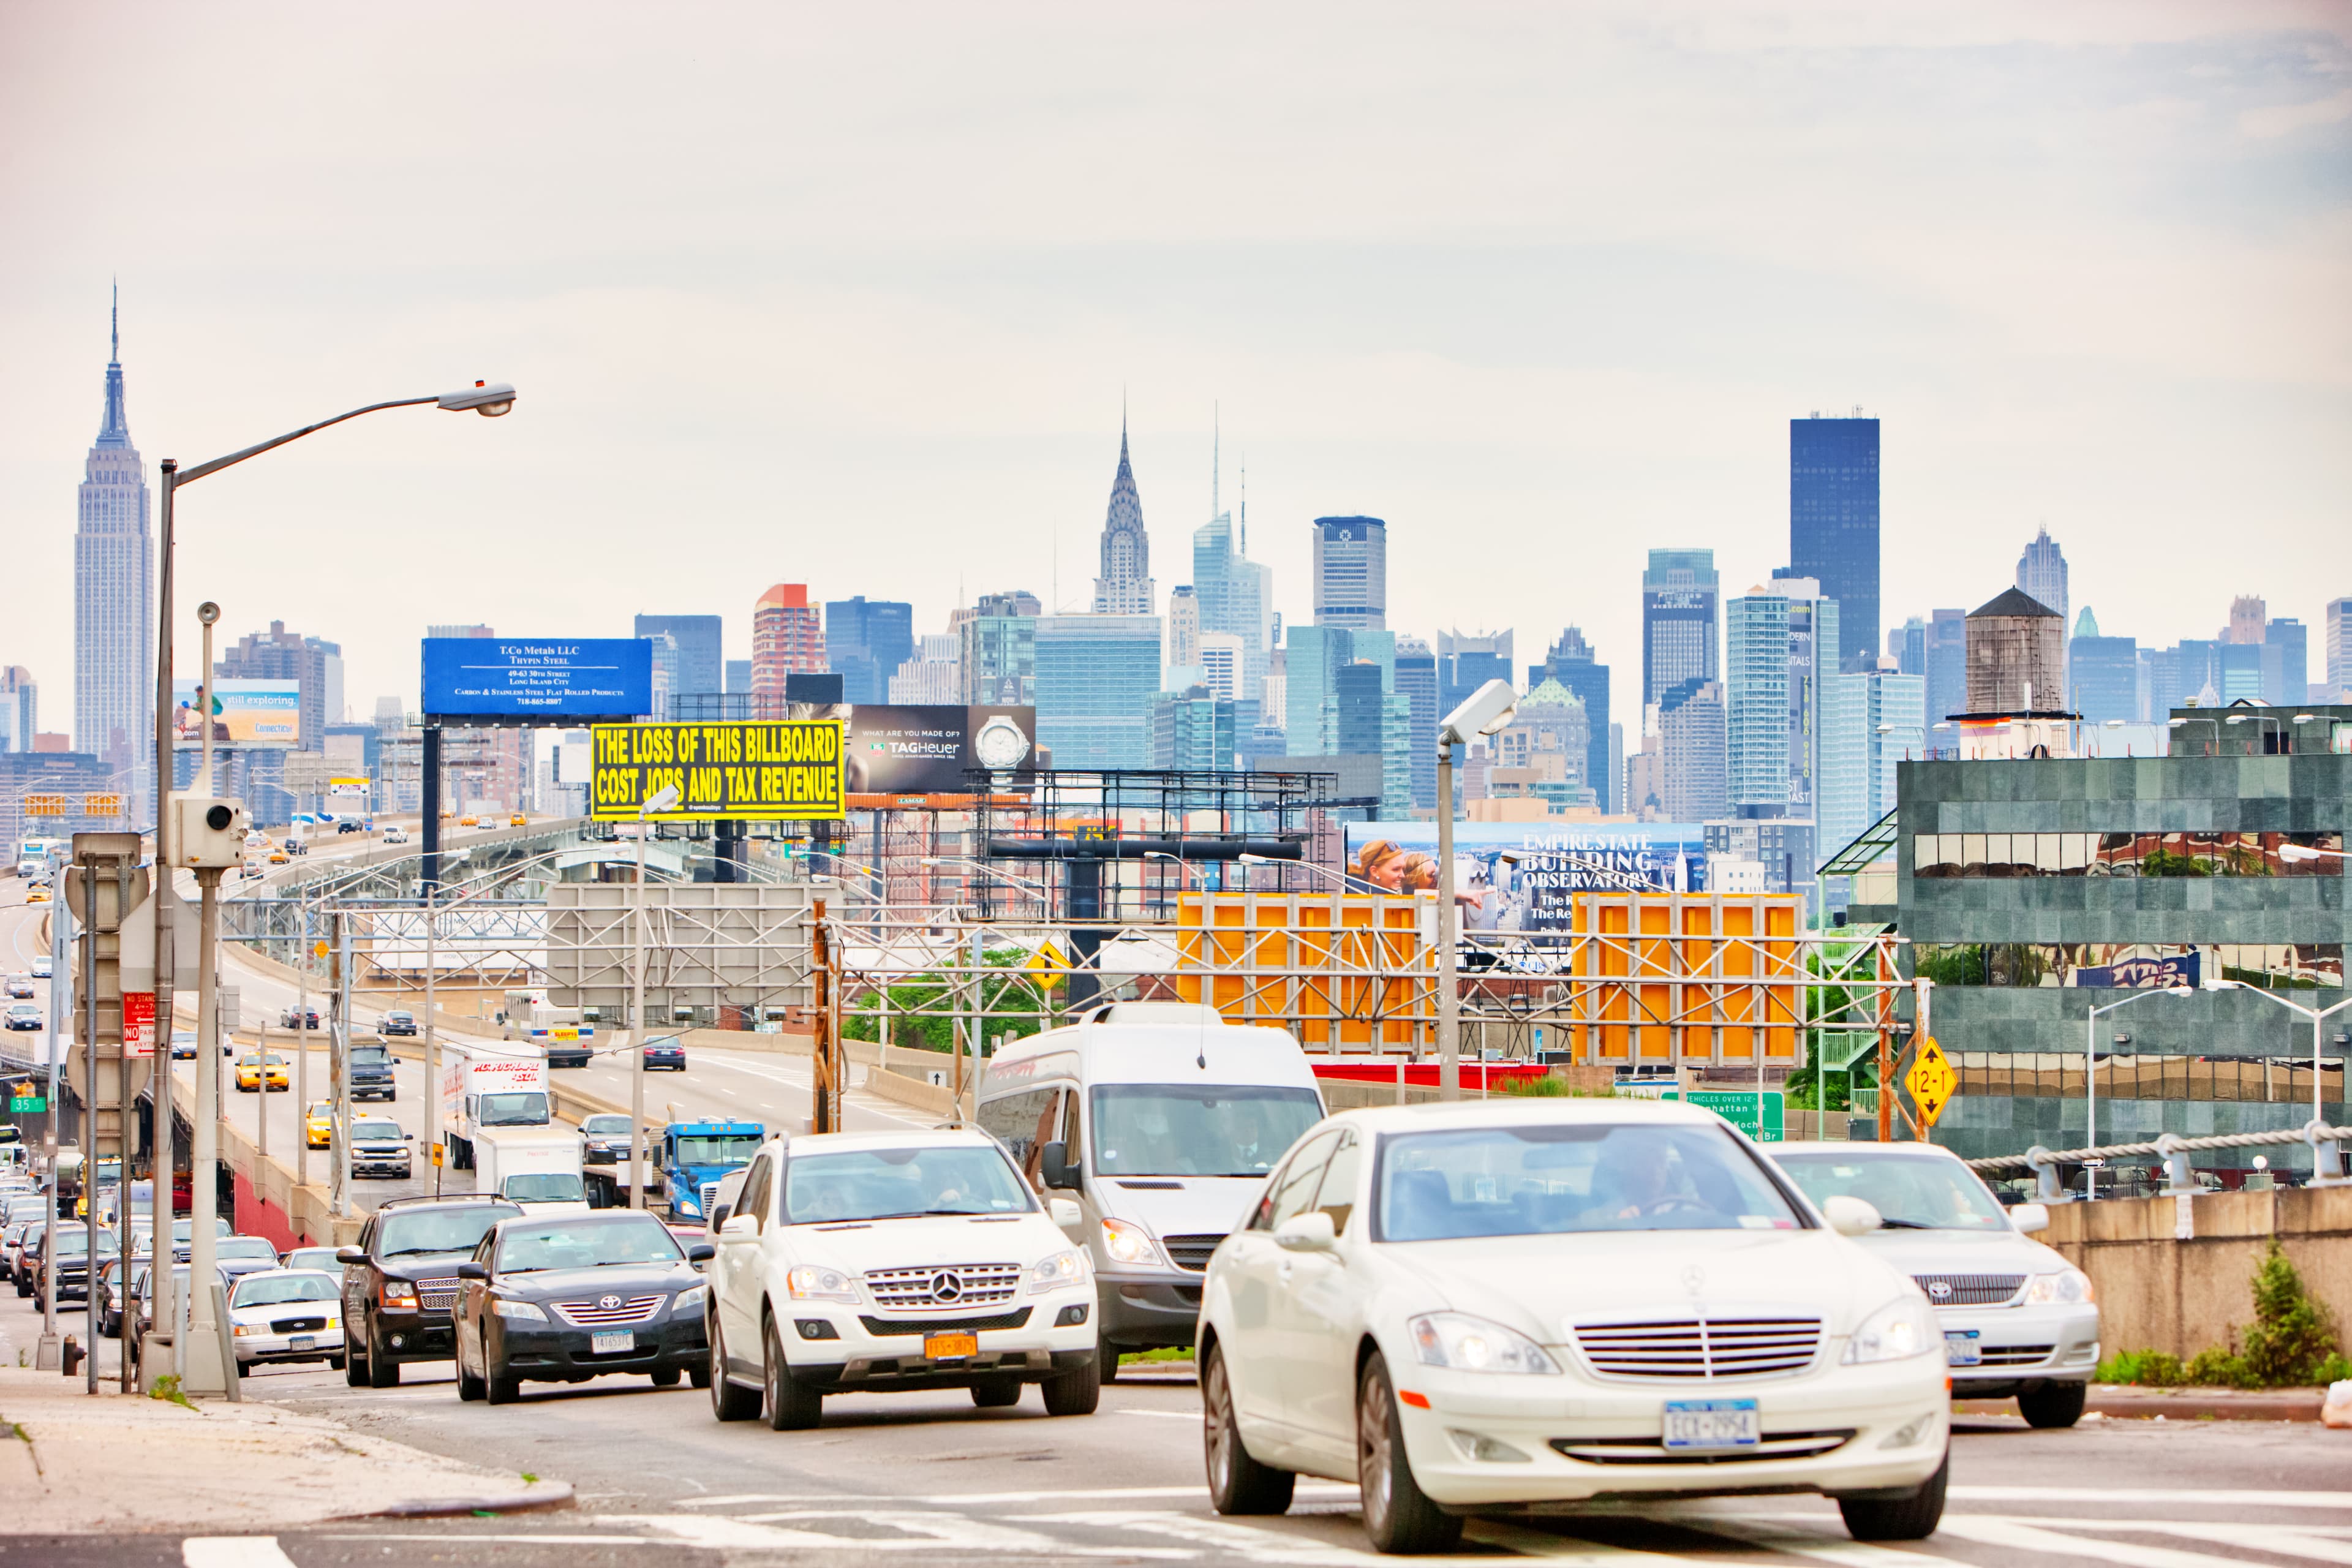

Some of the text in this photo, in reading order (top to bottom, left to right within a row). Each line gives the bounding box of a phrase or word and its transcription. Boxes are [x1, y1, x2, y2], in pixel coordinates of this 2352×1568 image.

[1789, 632, 1811, 642] DERN
[500, 646, 579, 655] T.Co Metals LLC
[543, 656, 570, 665] STEEL
[1789, 656, 1811, 666] NTALS
[227, 695, 296, 706] still exploring.
[597, 726, 836, 764] THE LOSS OF THIS BILLBOARD
[597, 768, 639, 803] COST
[688, 767, 722, 802] AND
[725, 767, 758, 802] TAX
[762, 766, 837, 802] REVENUE
[1789, 780, 1798, 792] ST
[1523, 834, 1653, 850] EMPIRE STATE
[1524, 851, 1653, 871] BUILDING
[1522, 872, 1652, 888] OBSERVATORY
[1541, 895, 1564, 906] The
[1531, 908, 1572, 919] The Re
[126, 1027, 138, 1039] NO
[16, 1099, 29, 1110] 35
[1765, 1132, 1776, 1140] Br
